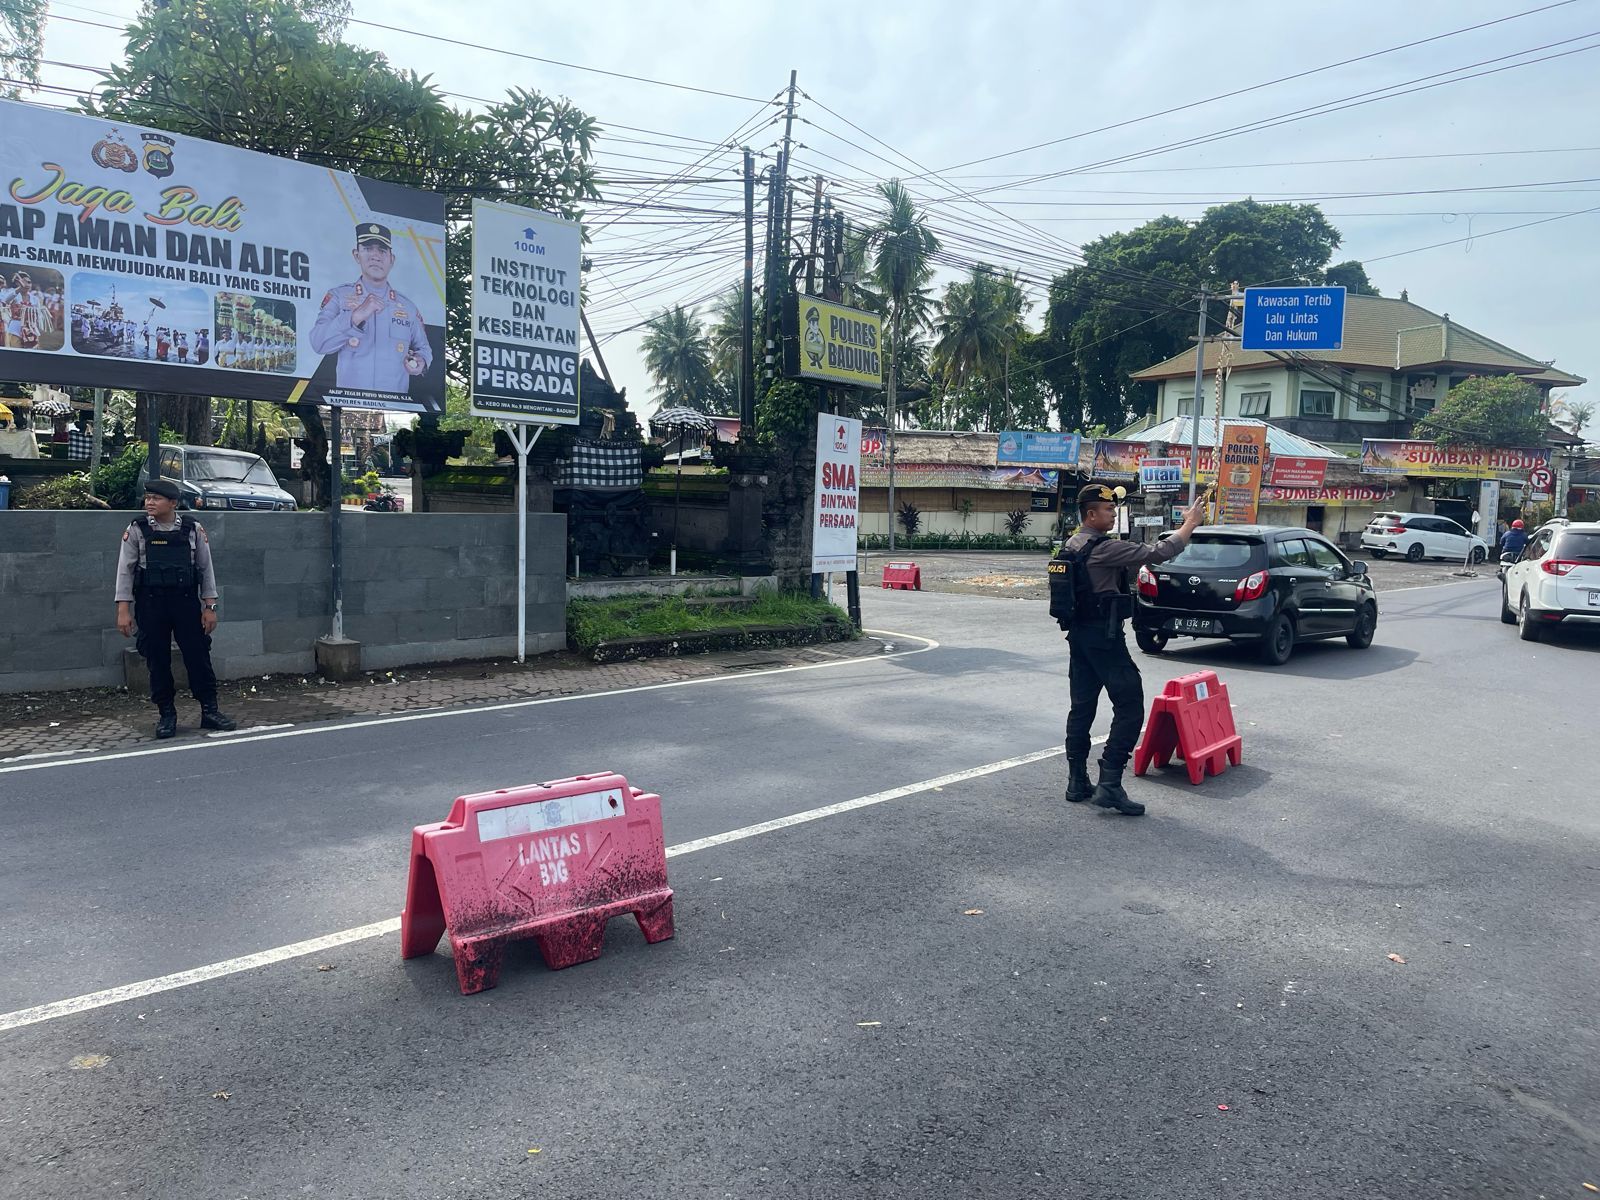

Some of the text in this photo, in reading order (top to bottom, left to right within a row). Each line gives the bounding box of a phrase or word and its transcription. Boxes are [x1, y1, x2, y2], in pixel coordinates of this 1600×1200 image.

[145, 135, 171, 143] BALI
[9, 162, 248, 232] Jaga Bali
[0, 204, 310, 283] AP AMAN DAN AJEG
[514, 241, 546, 255] 100M
[0, 243, 311, 299] MA-SAMA MEWUJUDKAN BALI YANG SHANTI
[491, 257, 567, 286] INSTITUT
[480, 276, 575, 307] TEKNOLOGI
[1257, 294, 1332, 307] Kawasan Tertib
[512, 302, 546, 322] DAN
[1266, 313, 1318, 324] Lalu Lintas
[478, 316, 576, 345] KESEHATAN
[830, 315, 877, 349] POLRES
[1265, 330, 1318, 341] Dan Hukum
[477, 346, 576, 375] BINTANG
[828, 343, 880, 377] BADUNG
[477, 367, 575, 396] PERSADA
[330, 398, 386, 408] KAPOLRES BADUNG
[1228, 444, 1259, 454] POLRES
[1225, 455, 1259, 464] BADUNG
[1408, 452, 1548, 471] SUMBAR HIDUP
[822, 461, 857, 491] SMA
[1143, 467, 1180, 481] Utari
[821, 494, 857, 510] BINTANG
[1274, 488, 1395, 502] SUMBAR HIDUP
[820, 513, 855, 529] PERSADA
[518, 832, 581, 867] LANTAS
